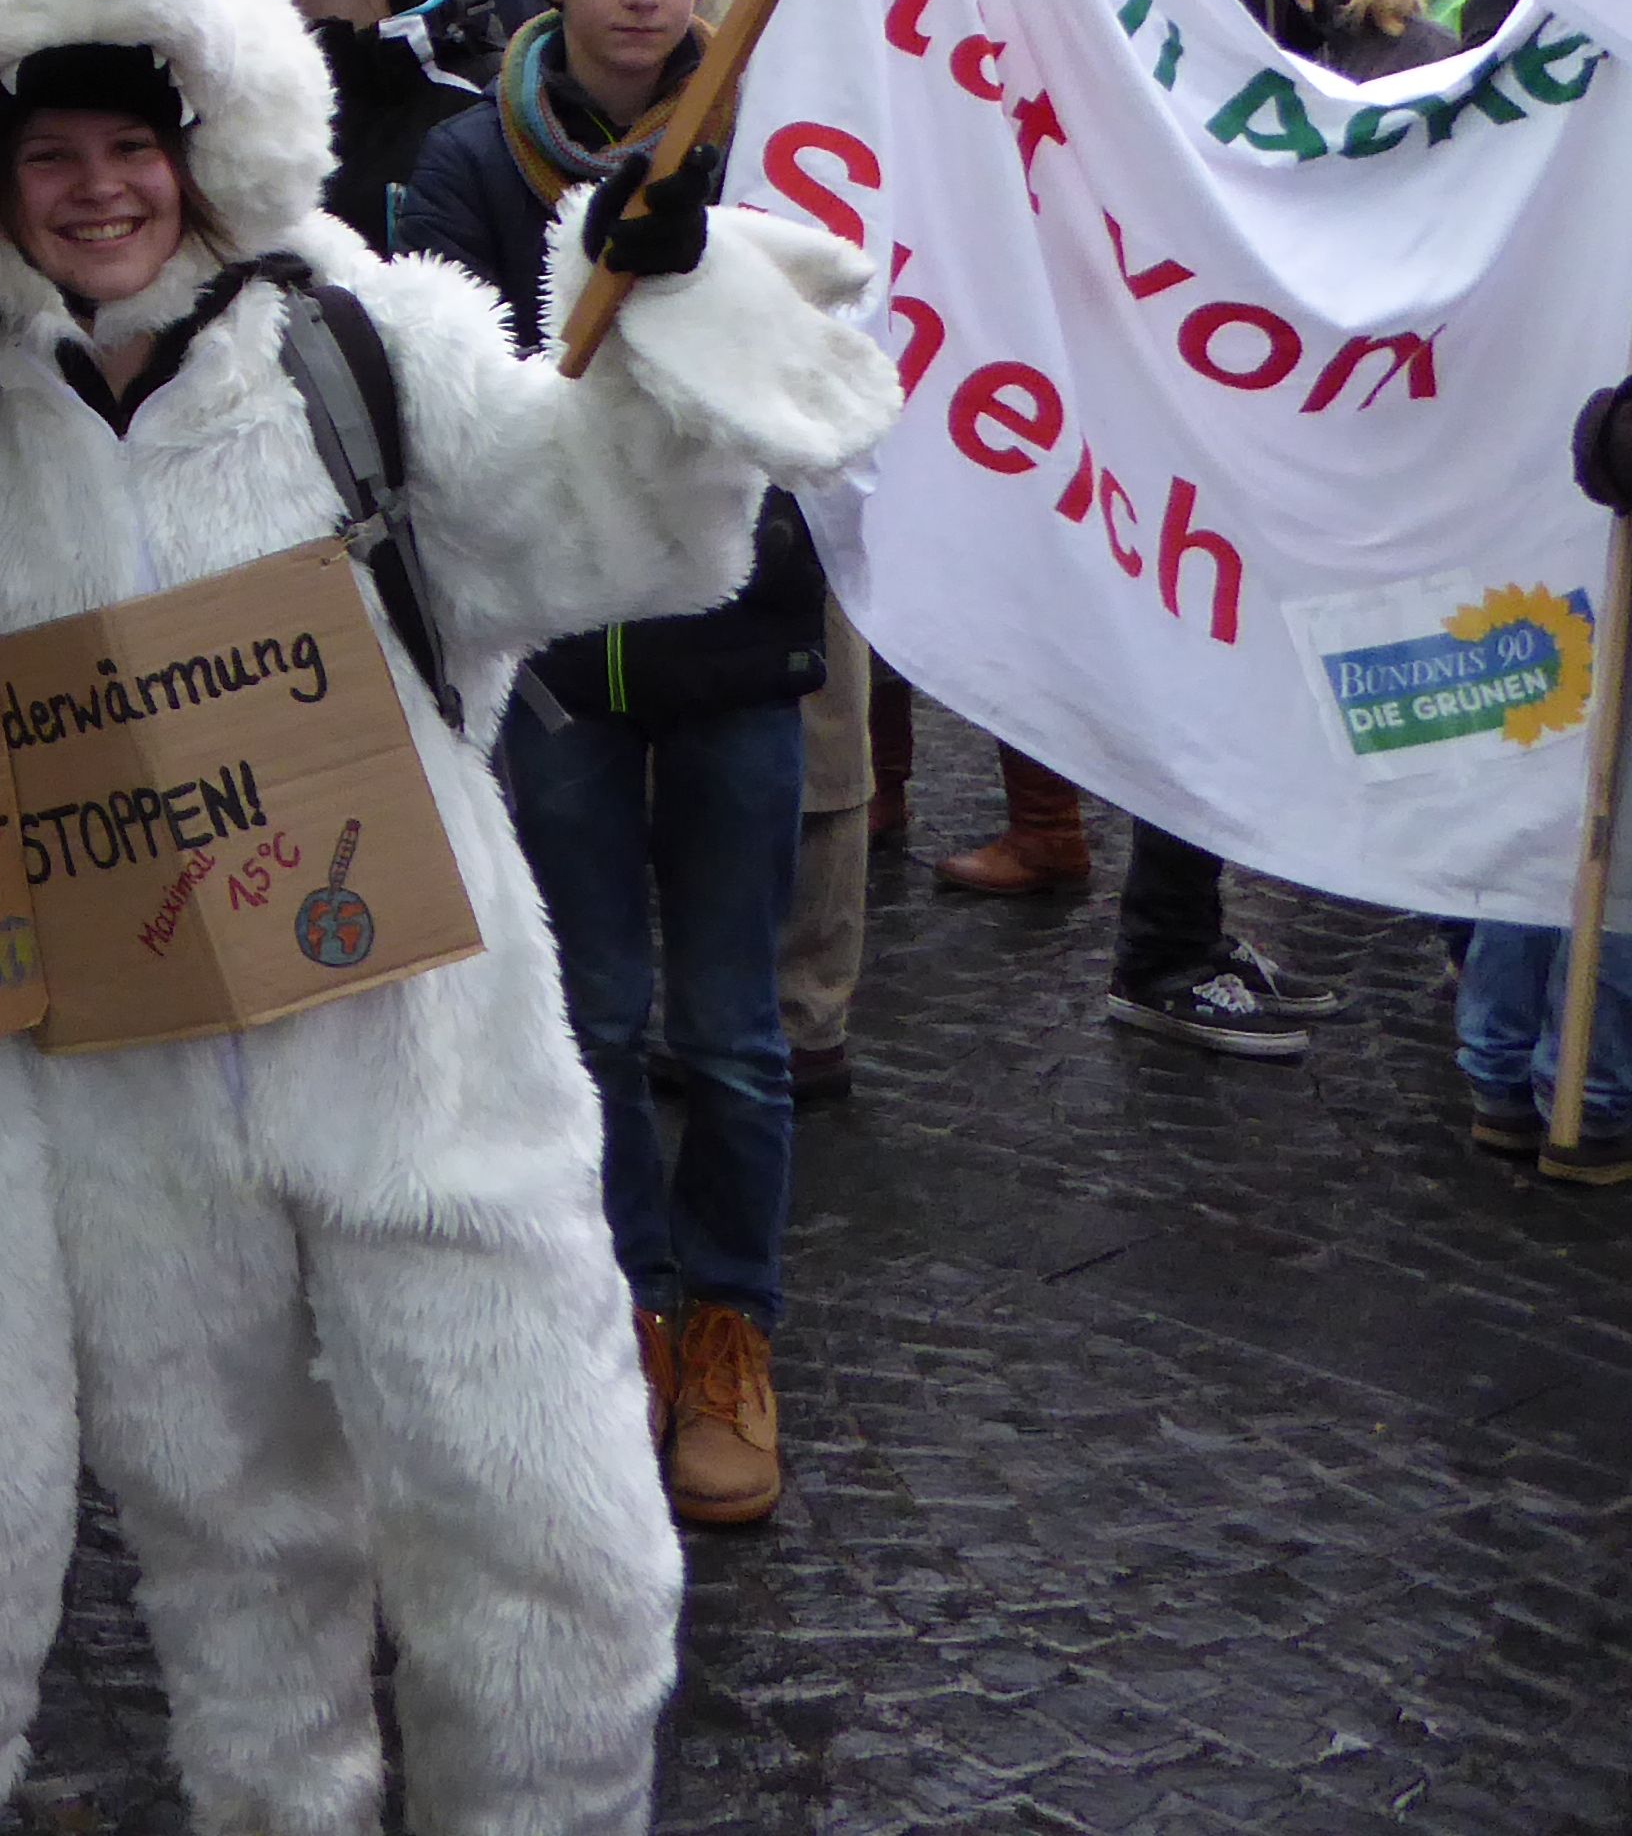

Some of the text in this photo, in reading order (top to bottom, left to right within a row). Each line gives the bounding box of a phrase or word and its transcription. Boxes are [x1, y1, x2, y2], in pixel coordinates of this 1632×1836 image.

[2, 631, 328, 749] derwärmung
[1495, 628, 1536, 670] 90
[1347, 668, 1548, 734] DIE GRÜNEN
[20, 760, 268, 886] STOPPEN!
